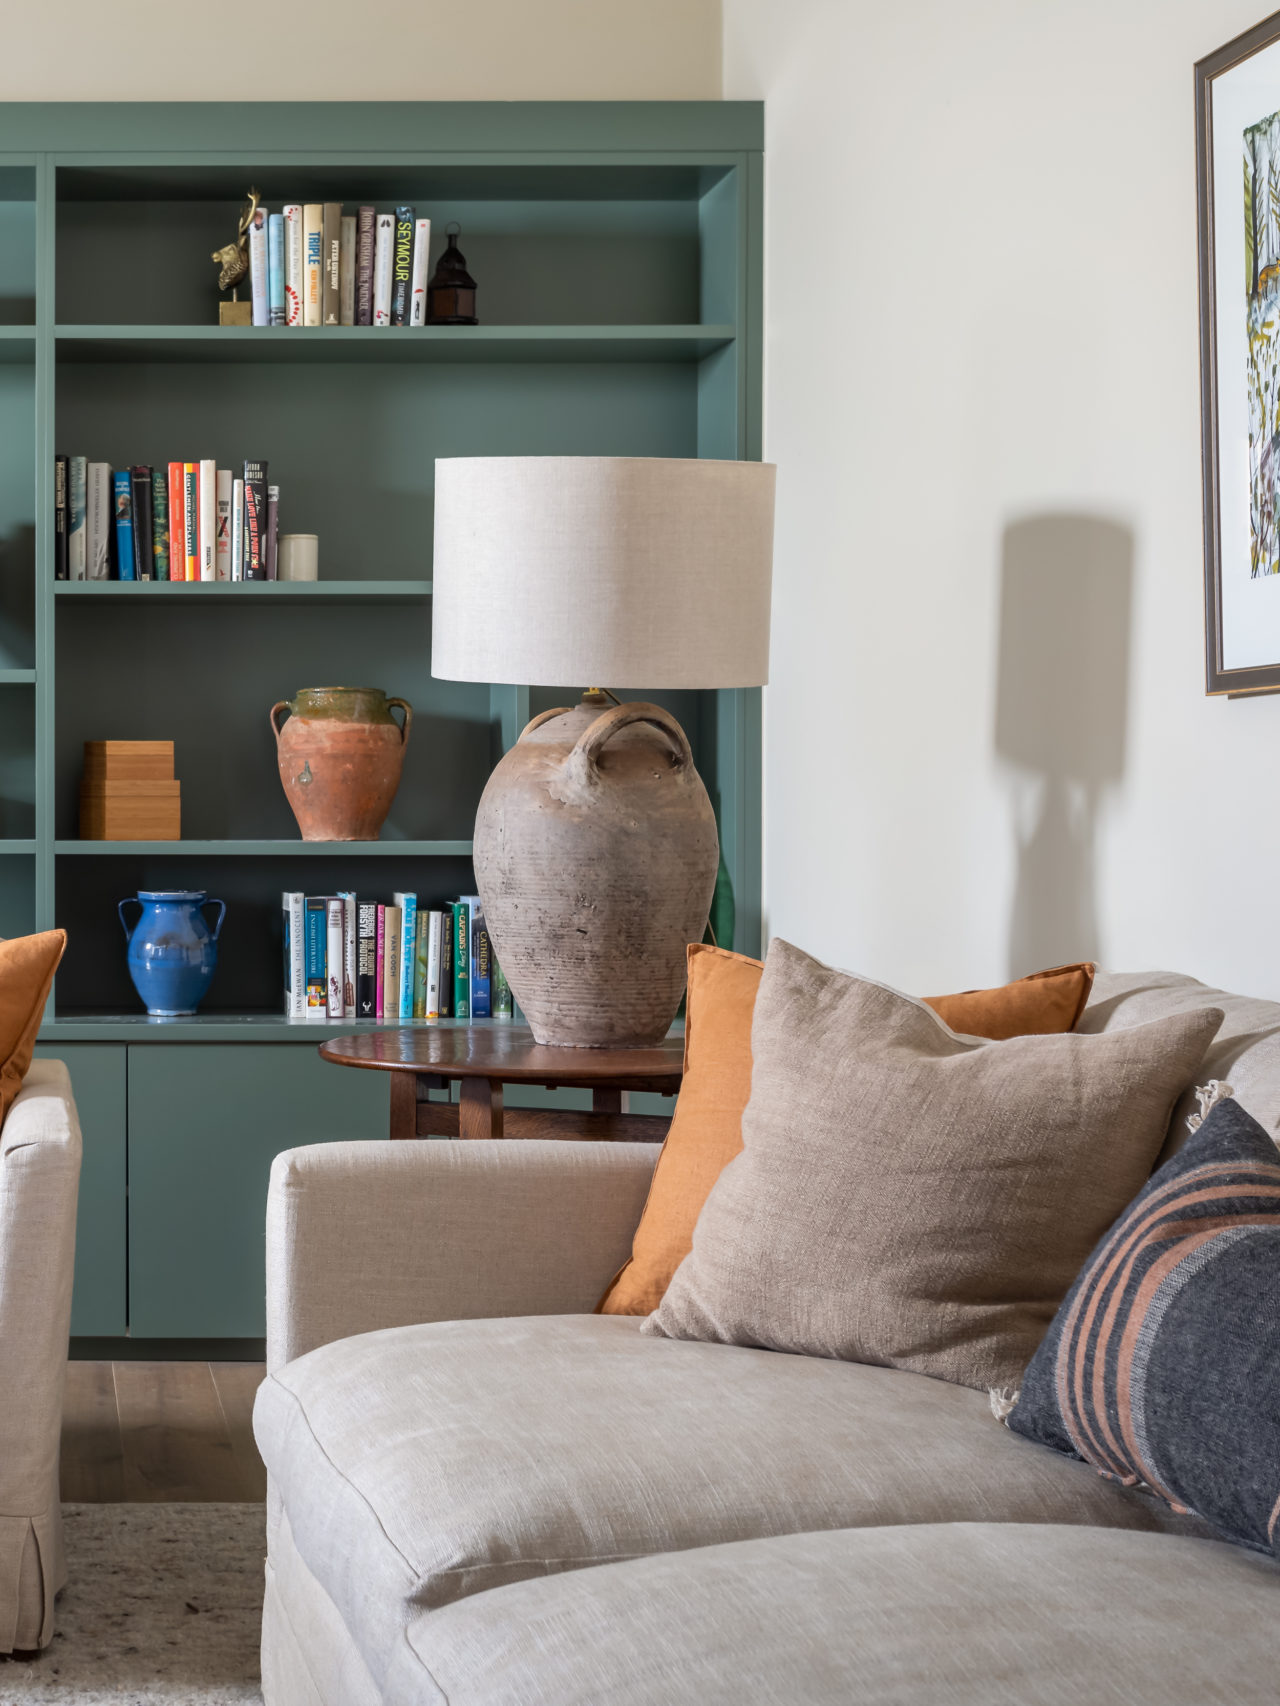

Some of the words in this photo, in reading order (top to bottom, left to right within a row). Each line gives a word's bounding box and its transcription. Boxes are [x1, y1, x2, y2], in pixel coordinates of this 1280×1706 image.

[361, 211, 373, 231] JOHN
[308, 231, 320, 265] TRIPLE
[331, 239, 339, 261] PETER
[360, 232, 373, 267] GRISHAM
[395, 222, 412, 281] SEYMOUR
[331, 262, 339, 290] USTINOV
[360, 269, 370, 282] THE
[358, 283, 370, 312] PARTNER
[396, 282, 406, 315] TIMEBOMB
[245, 485, 255, 502] MAKE
[247, 502, 257, 518] LOVE
[249, 518, 258, 532] LIKE
[293, 911, 302, 947] INNOCENT
[359, 905, 368, 937] FORSYTH
[367, 905, 376, 937] FREDERICK
[294, 950, 302, 961] THE
[359, 939, 368, 976] PROTOCOL
[368, 939, 376, 950] THE
[480, 931, 488, 980] CATHEDRAL
[368, 952, 376, 976] FOURTH
[458, 950, 467, 968] Diary
[295, 968, 303, 998] McEWAN
